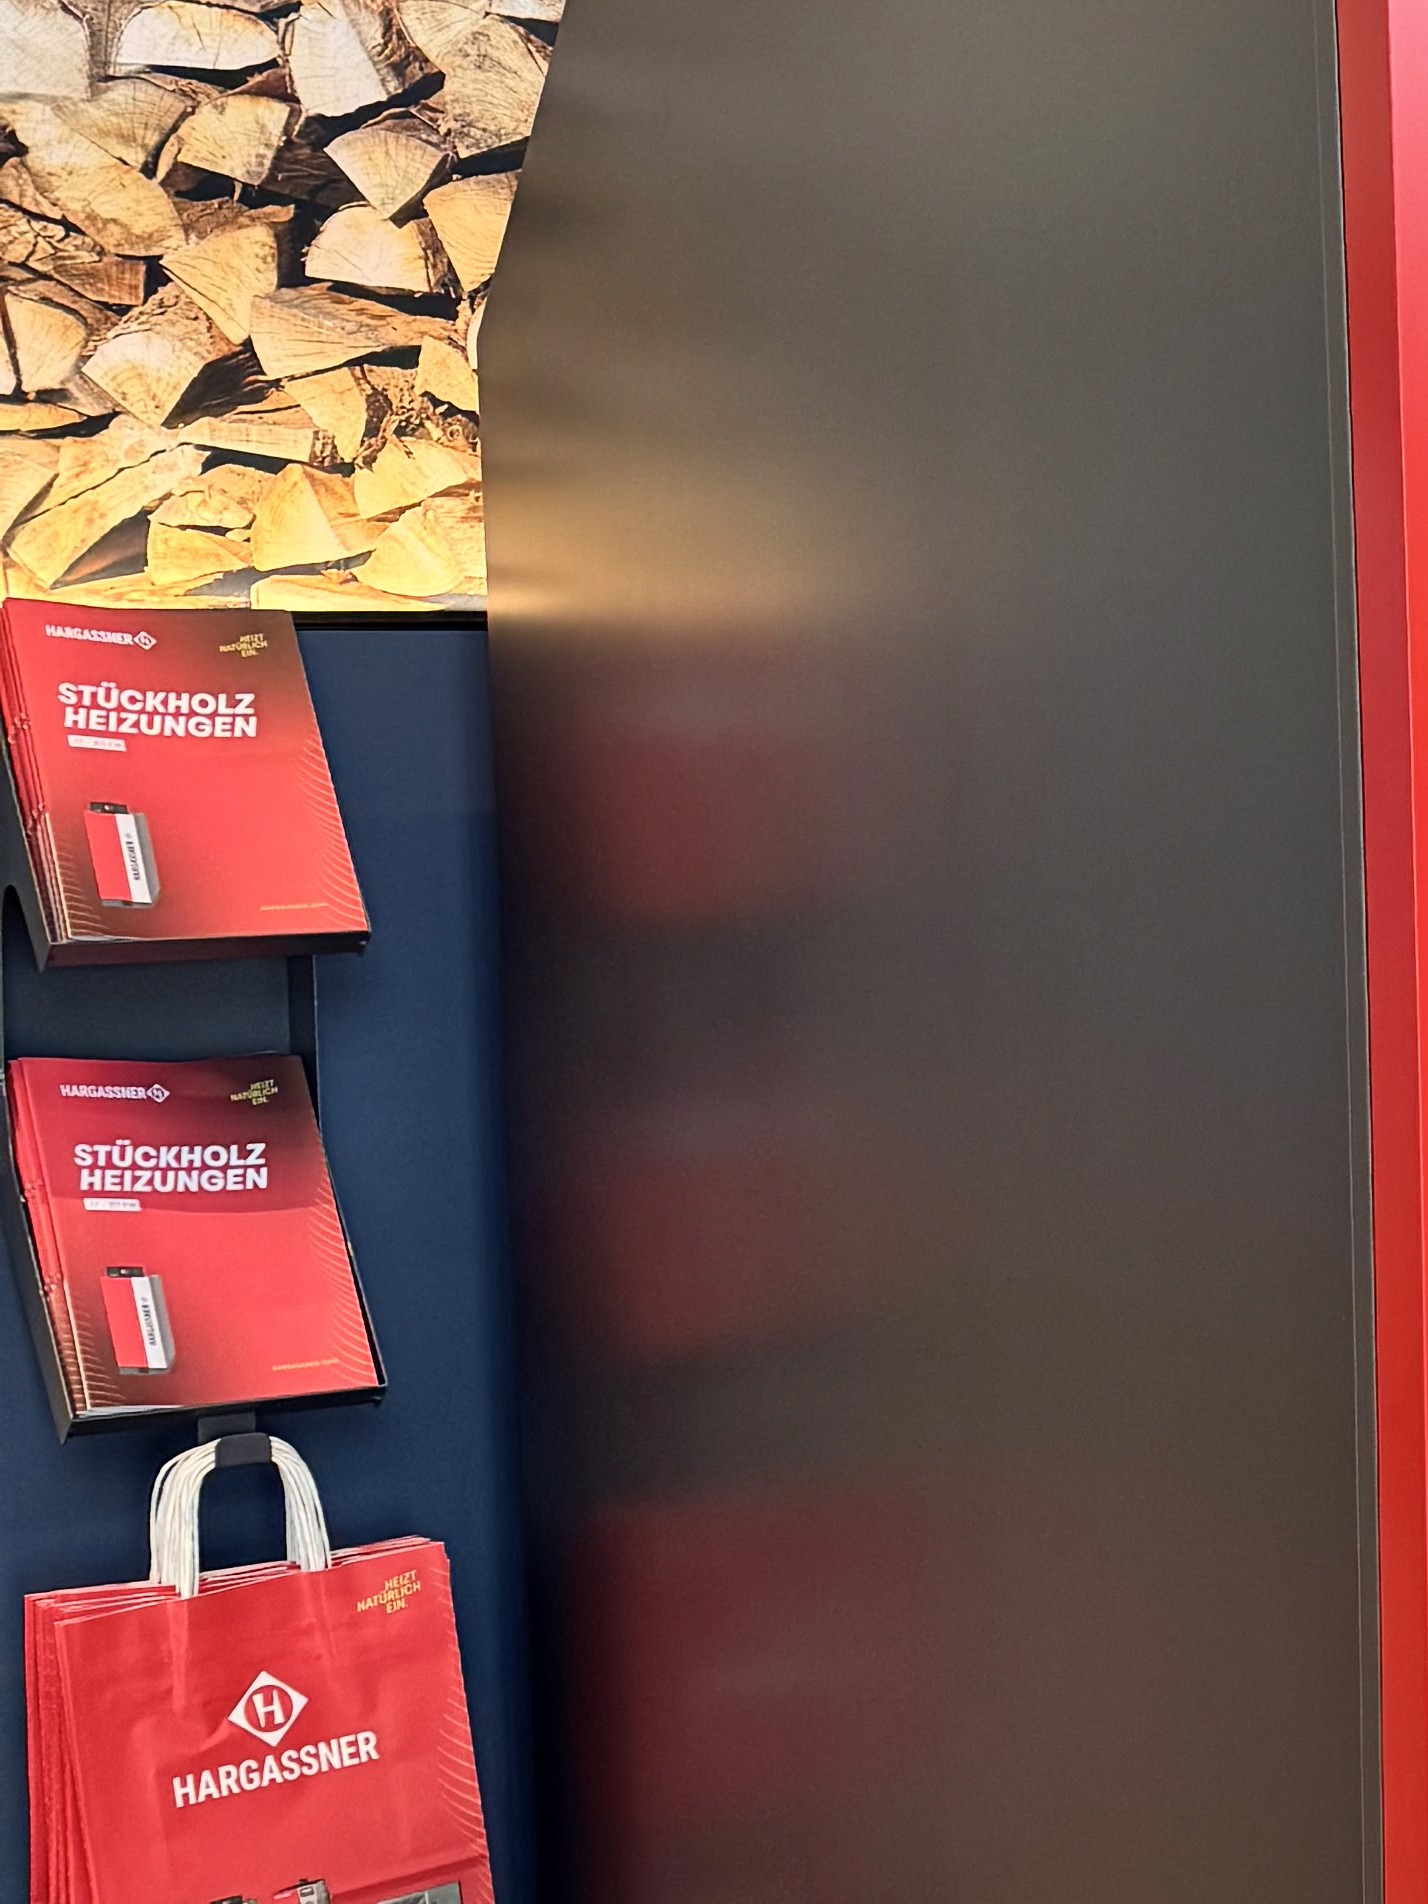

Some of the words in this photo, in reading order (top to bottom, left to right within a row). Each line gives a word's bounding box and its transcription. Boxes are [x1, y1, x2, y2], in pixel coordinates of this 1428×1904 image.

[58, 681, 255, 715] STÜCKHOLZ
[64, 706, 257, 737] HEIZUNGEN
[74, 1139, 267, 1168] STÜCKHOLZ
[80, 1167, 268, 1193] HEIZUNGEN
[384, 1569, 417, 1590] HEIZT
[357, 1581, 421, 1612] NATÜRLICH
[172, 1731, 380, 1808] HARGASSNER
